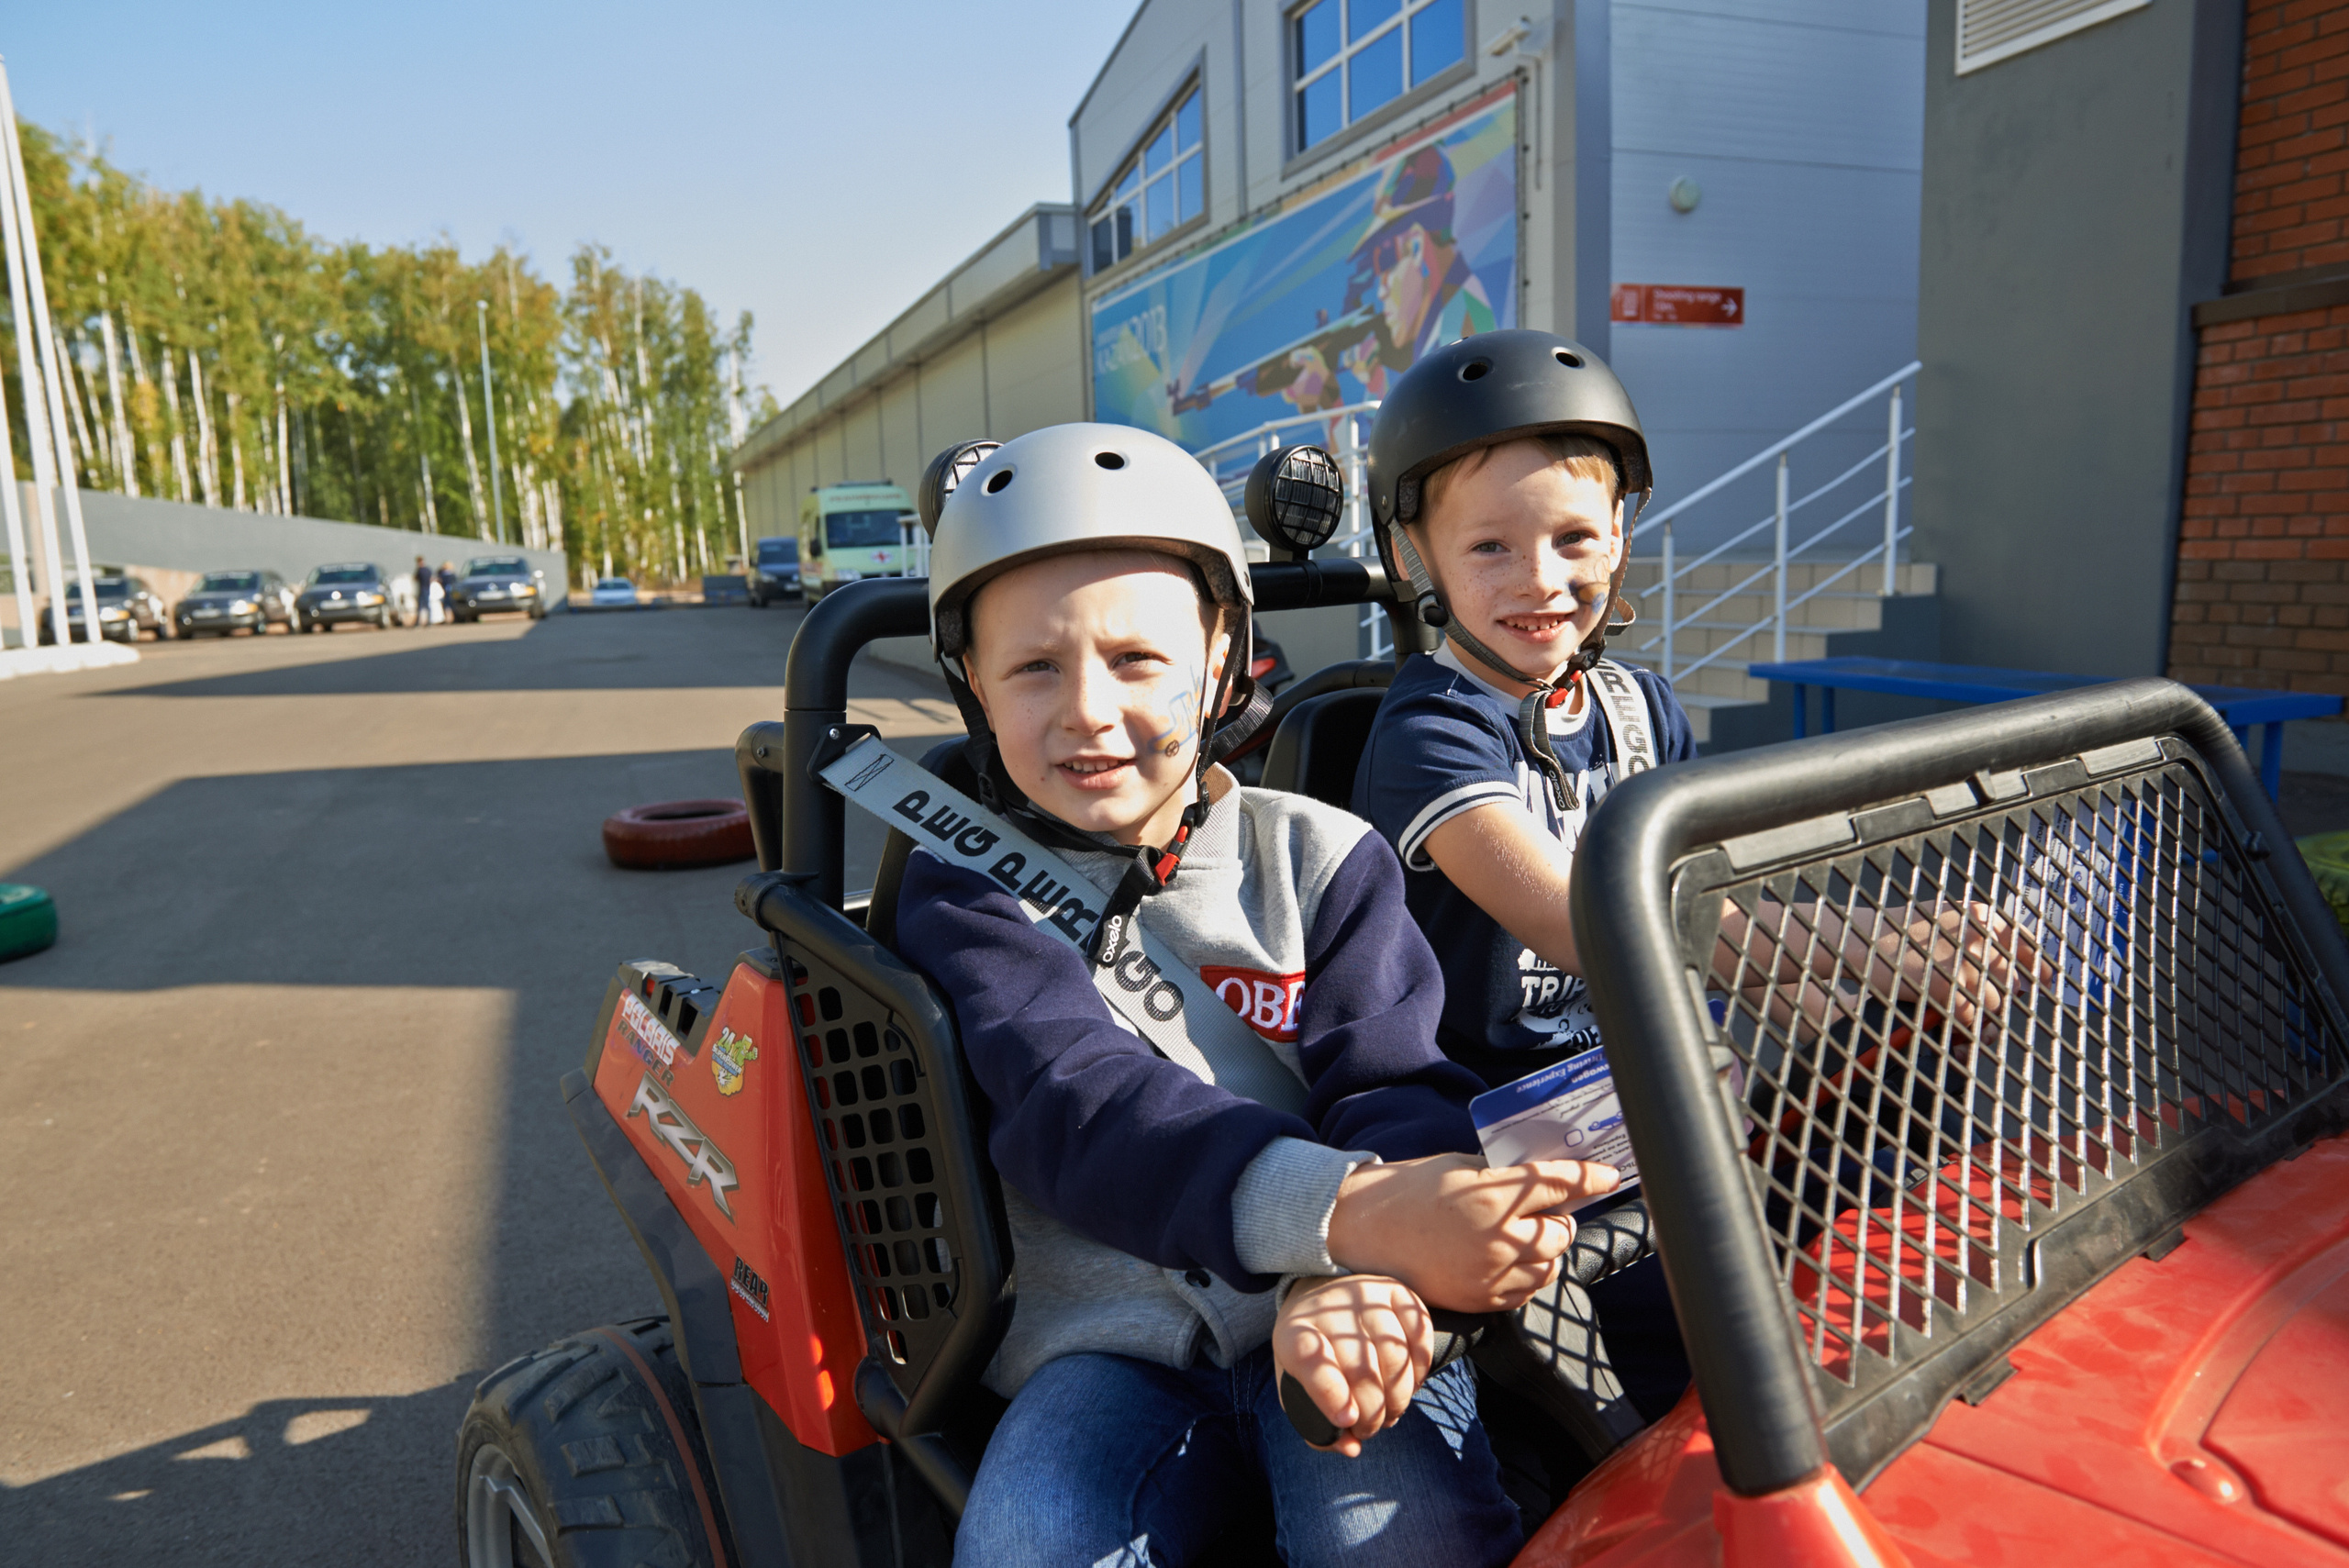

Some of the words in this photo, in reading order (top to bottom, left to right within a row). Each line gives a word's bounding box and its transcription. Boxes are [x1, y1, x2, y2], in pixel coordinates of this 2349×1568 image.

[892, 789, 1001, 857] PEG
[987, 851, 1185, 1022] PERGO
[1102, 915, 1122, 963] oxelo
[621, 993, 681, 1066] POLARIS
[1215, 977, 1306, 1031] OBE
[617, 1019, 674, 1087] RANGER
[1566, 1052, 1603, 1073] Driving
[1570, 1062, 1610, 1084] swagen
[1515, 1066, 1567, 1094] Experience
[627, 1070, 740, 1226] RZR
[733, 1254, 769, 1307] REAR
